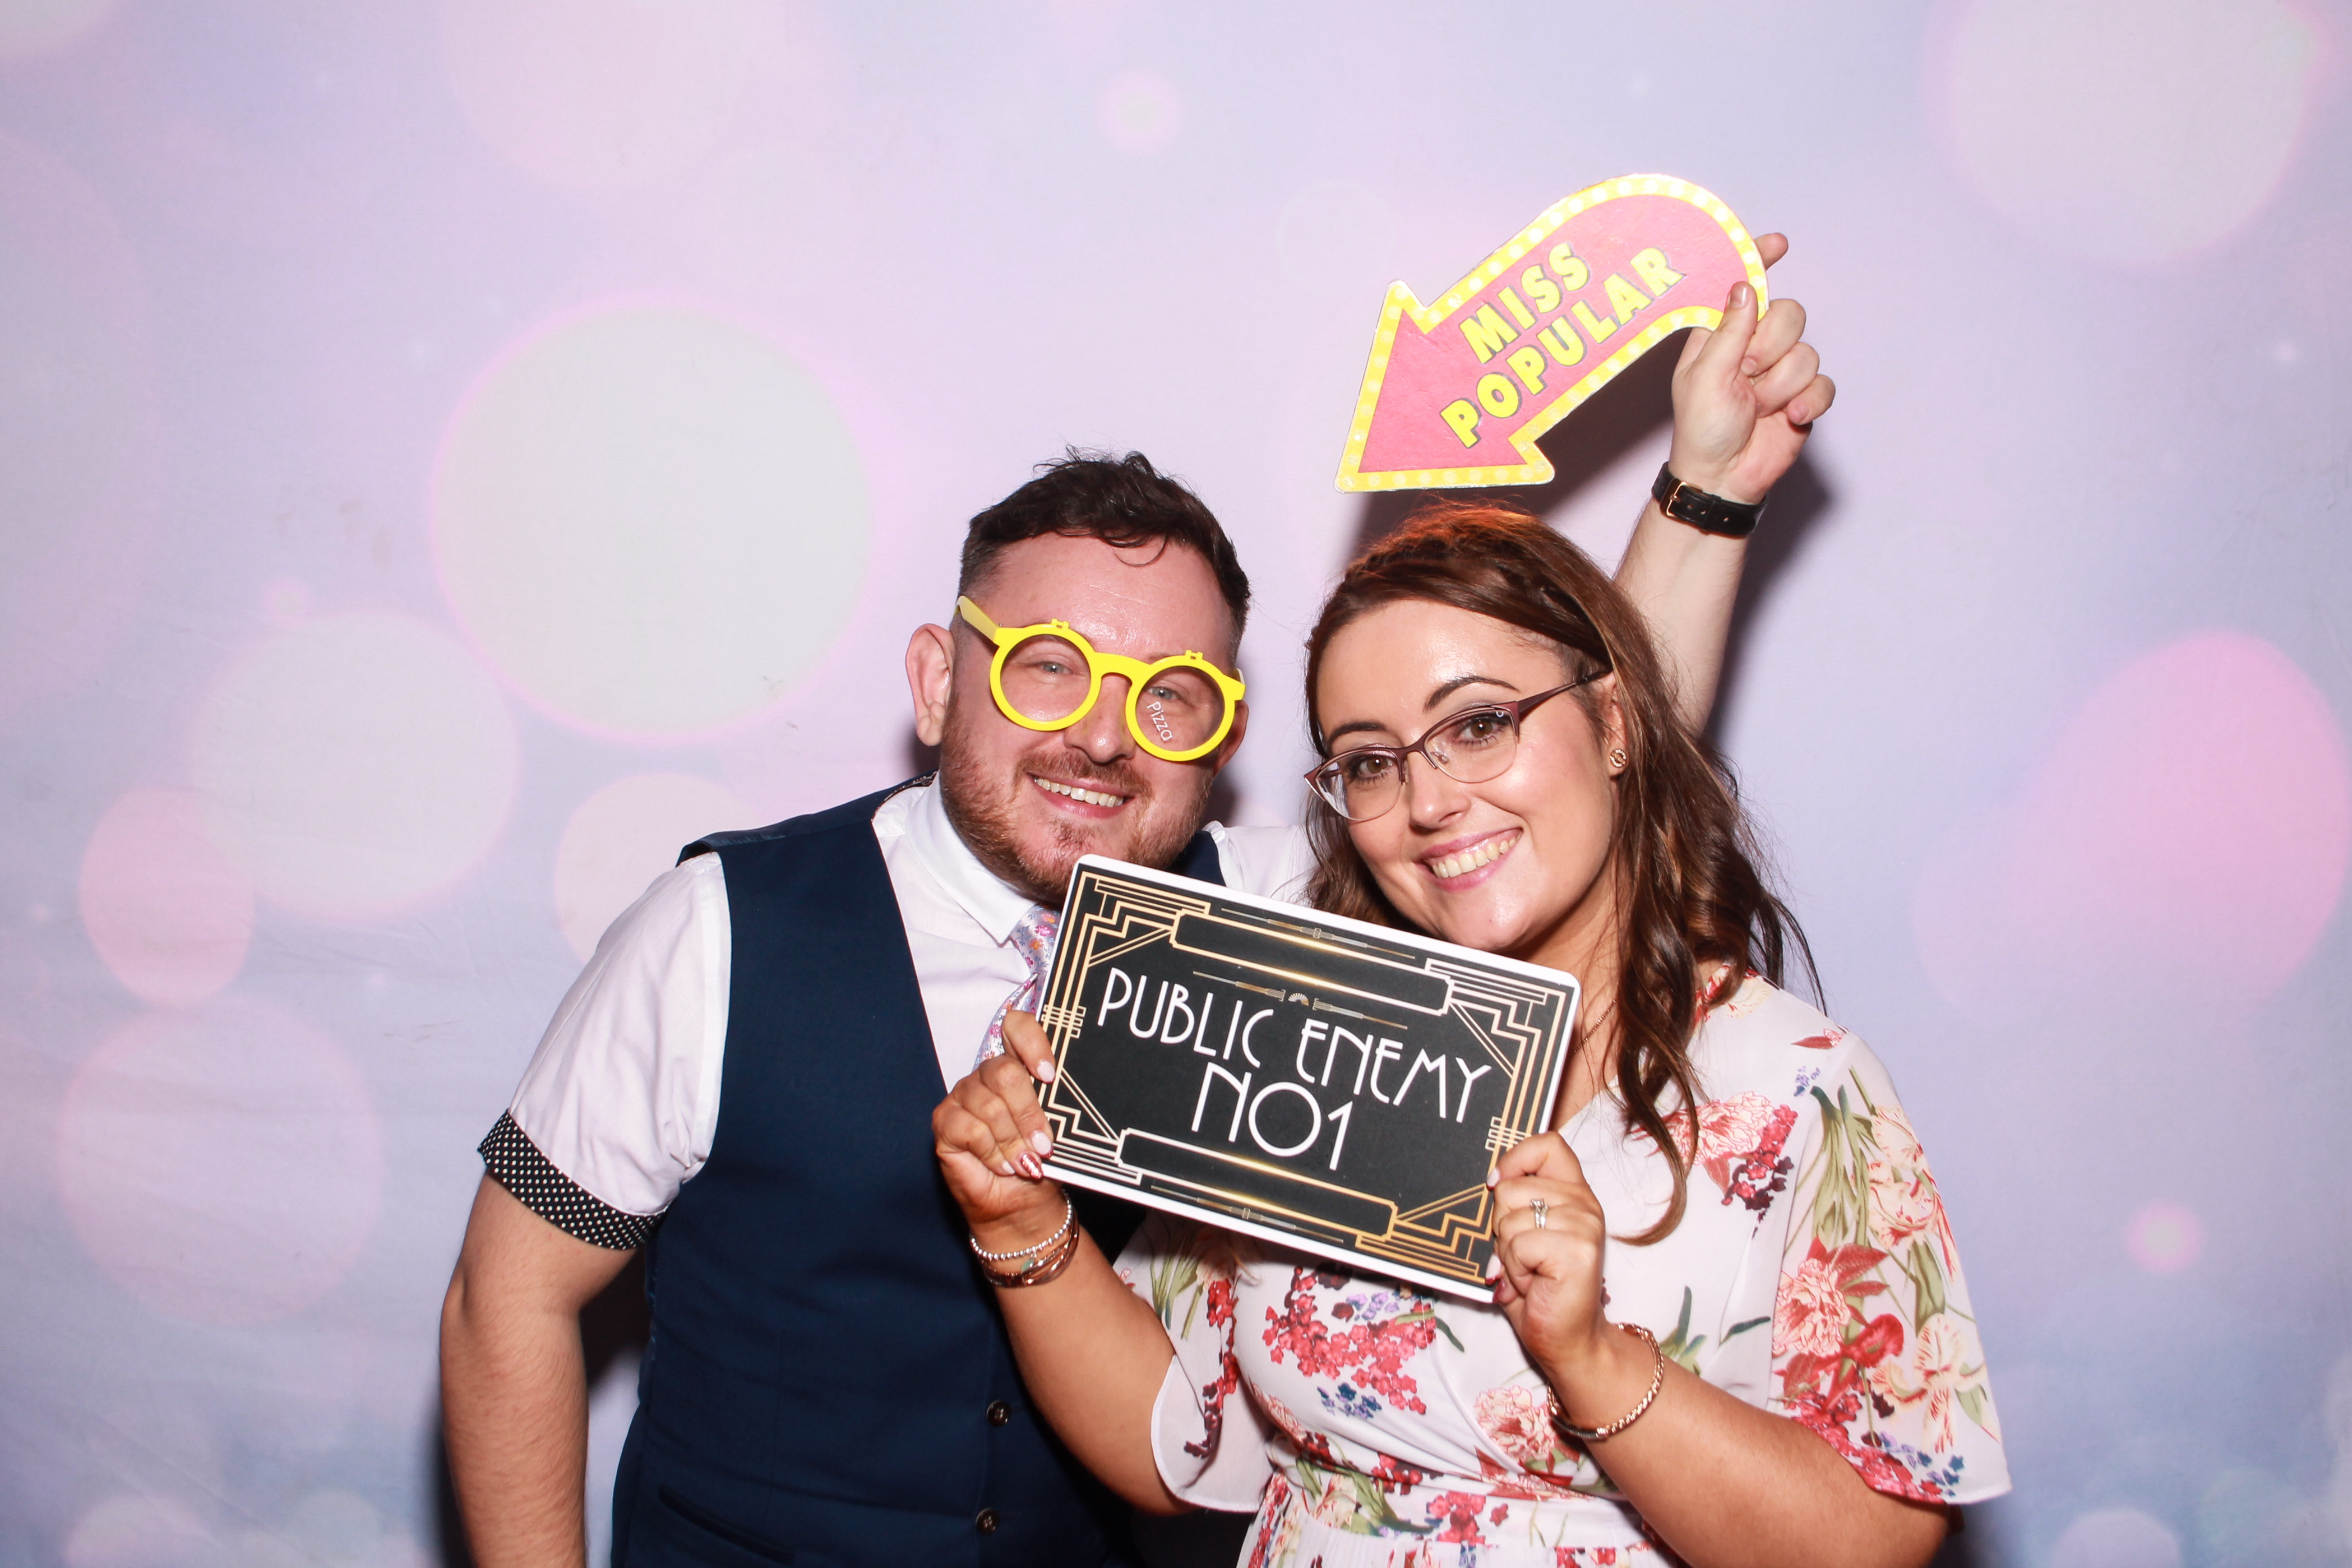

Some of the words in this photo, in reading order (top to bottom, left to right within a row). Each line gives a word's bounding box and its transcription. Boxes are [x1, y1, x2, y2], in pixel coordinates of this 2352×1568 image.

[1440, 247, 1686, 448] POPULAR
[1459, 242, 1591, 363] MISS
[1147, 701, 1173, 741] Pizza
[1097, 968, 1274, 1069] PUBLIC
[1296, 1018, 1492, 1123] ENEMY
